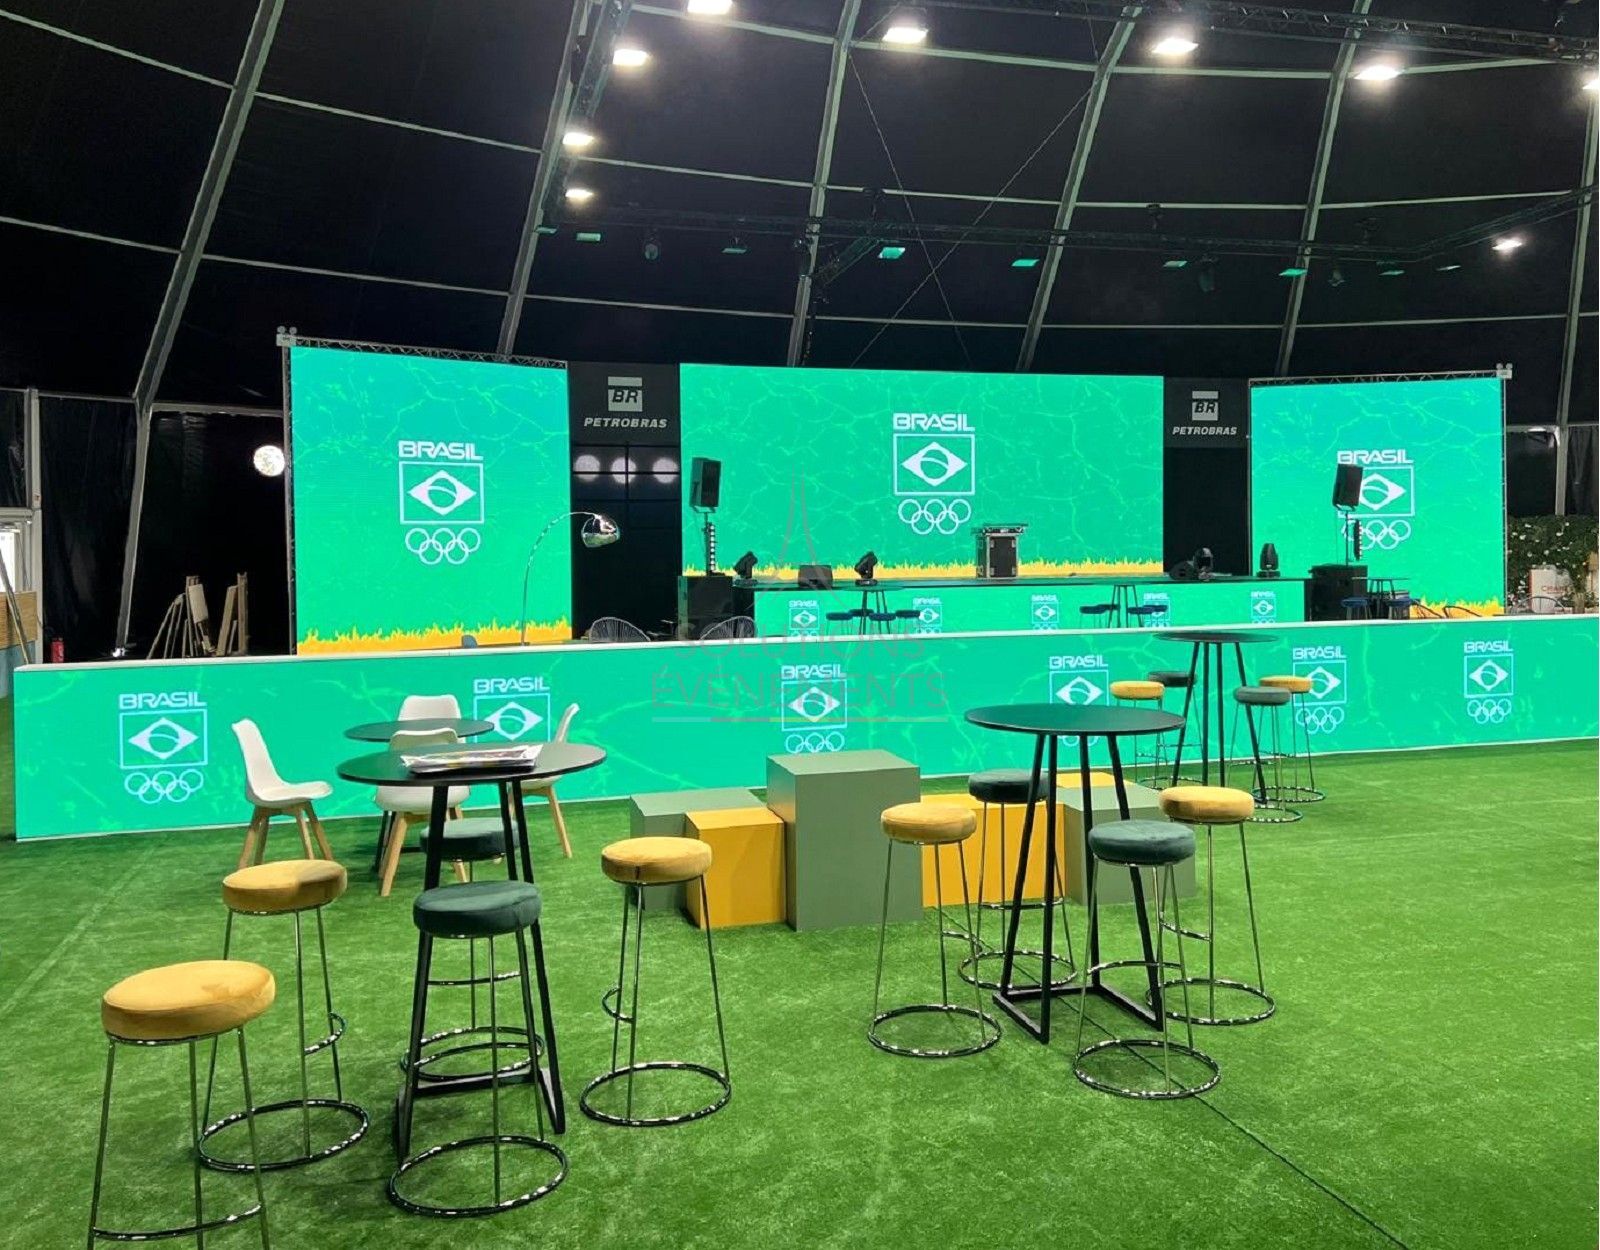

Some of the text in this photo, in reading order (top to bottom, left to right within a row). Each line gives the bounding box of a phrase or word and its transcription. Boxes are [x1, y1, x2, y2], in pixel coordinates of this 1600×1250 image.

[612, 389, 638, 403] BR
[1194, 401, 1216, 414] BR
[583, 417, 668, 428] PETROBRAS
[893, 412, 975, 433] BRASIL
[1172, 426, 1238, 435] PETROBRAS
[398, 440, 484, 461] BRASIL
[1337, 449, 1414, 465] BRASIL
[1293, 646, 1347, 660] BRASIL
[1464, 640, 1514, 653] BRASIL
[1049, 655, 1108, 670] BRASIL
[781, 664, 846, 679] BRASIL
[473, 676, 551, 694] BRASIL
[118, 691, 207, 710] BRASIL
